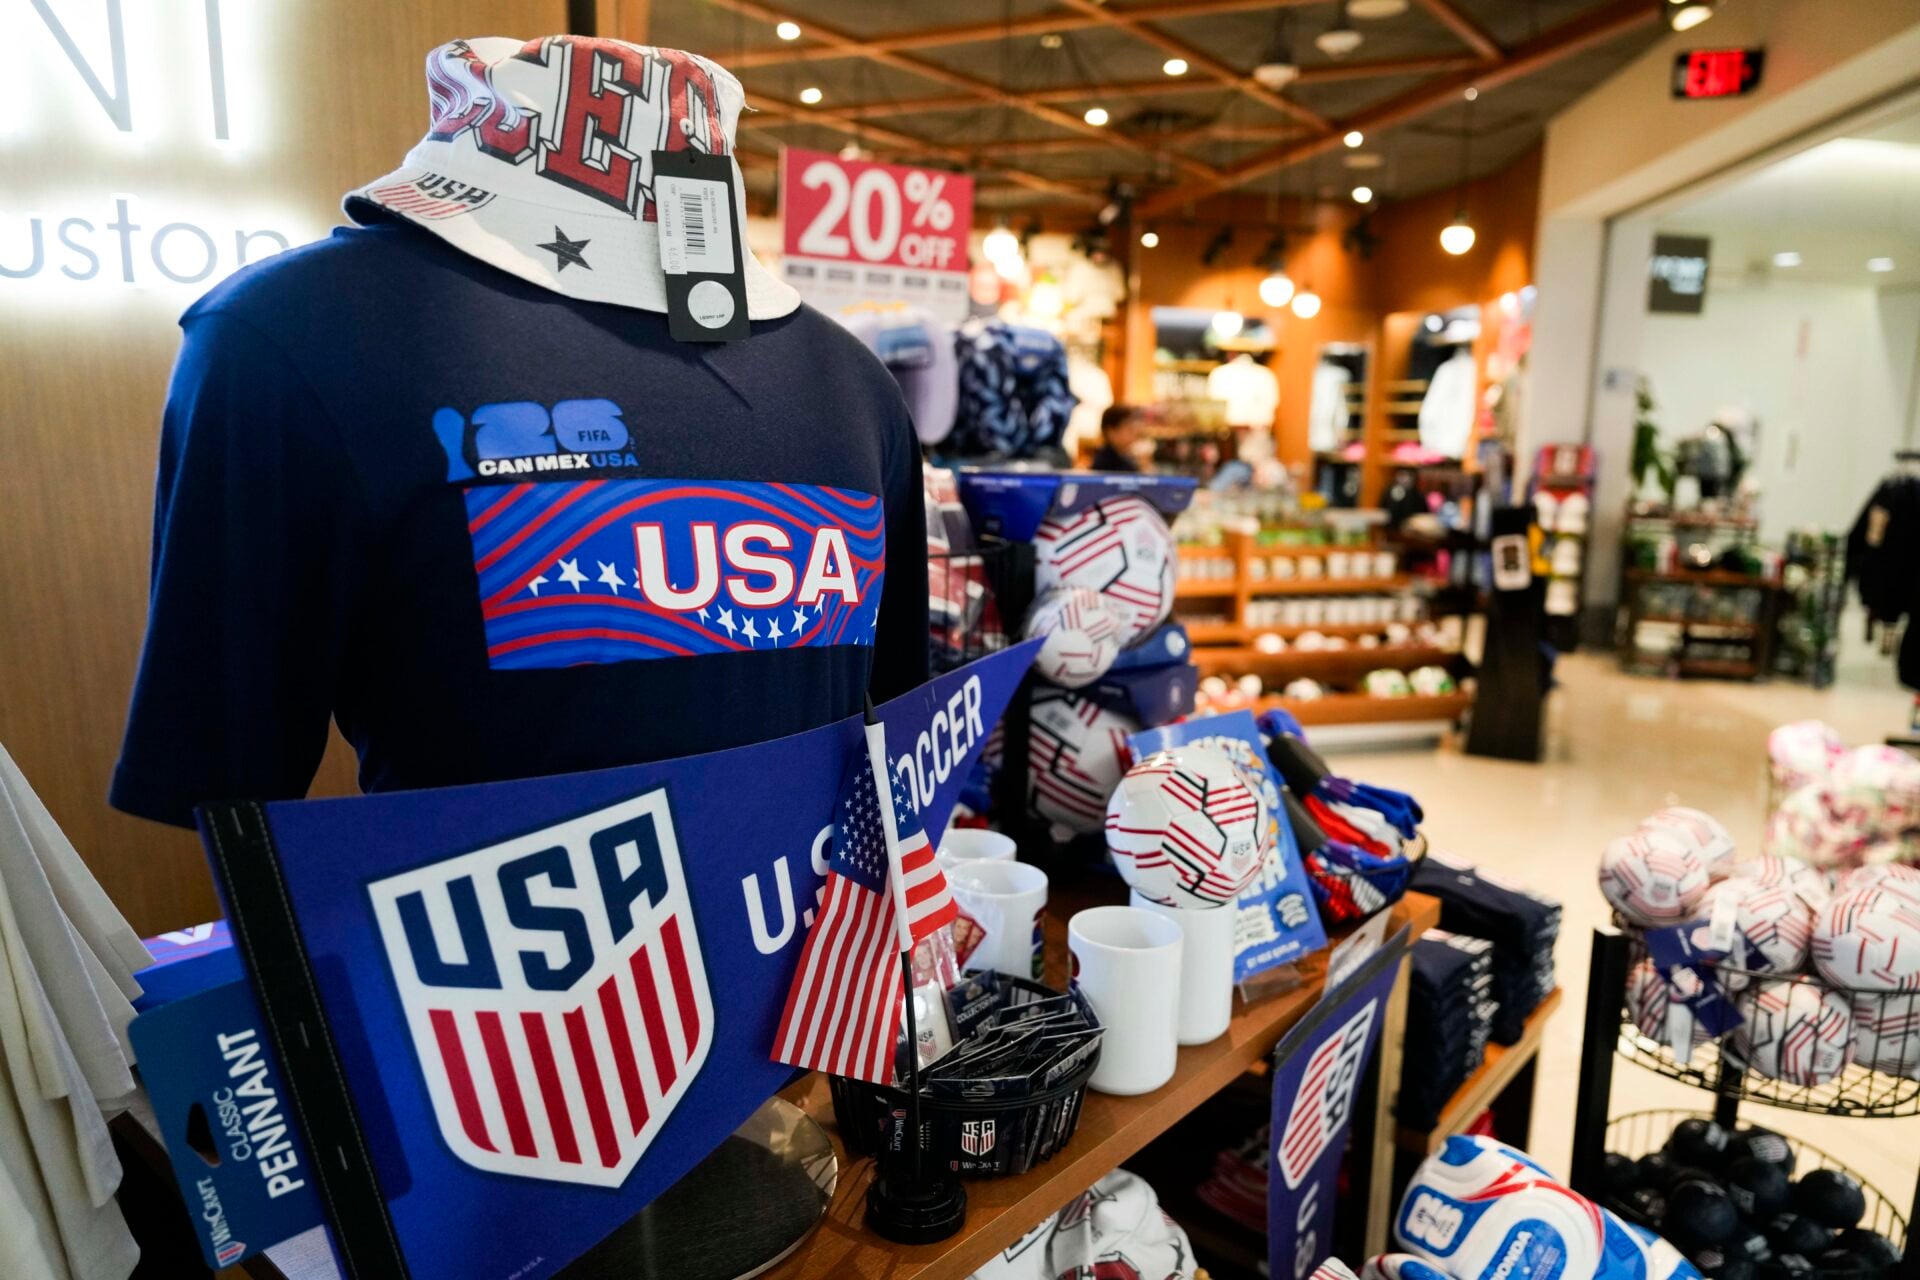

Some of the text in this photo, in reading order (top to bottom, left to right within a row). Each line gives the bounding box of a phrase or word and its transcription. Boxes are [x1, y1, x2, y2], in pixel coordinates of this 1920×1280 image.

[417, 172, 493, 206] USA
[900, 233, 957, 270] OFF
[478, 450, 640, 477] CAN MEX USA
[577, 429, 612, 444] FIFA
[633, 521, 860, 611] USA
[395, 811, 670, 992] USA
[1322, 1010, 1374, 1134] USA
[213, 1086, 252, 1162] CLASSIC
[216, 1029, 306, 1200] PENNANT
